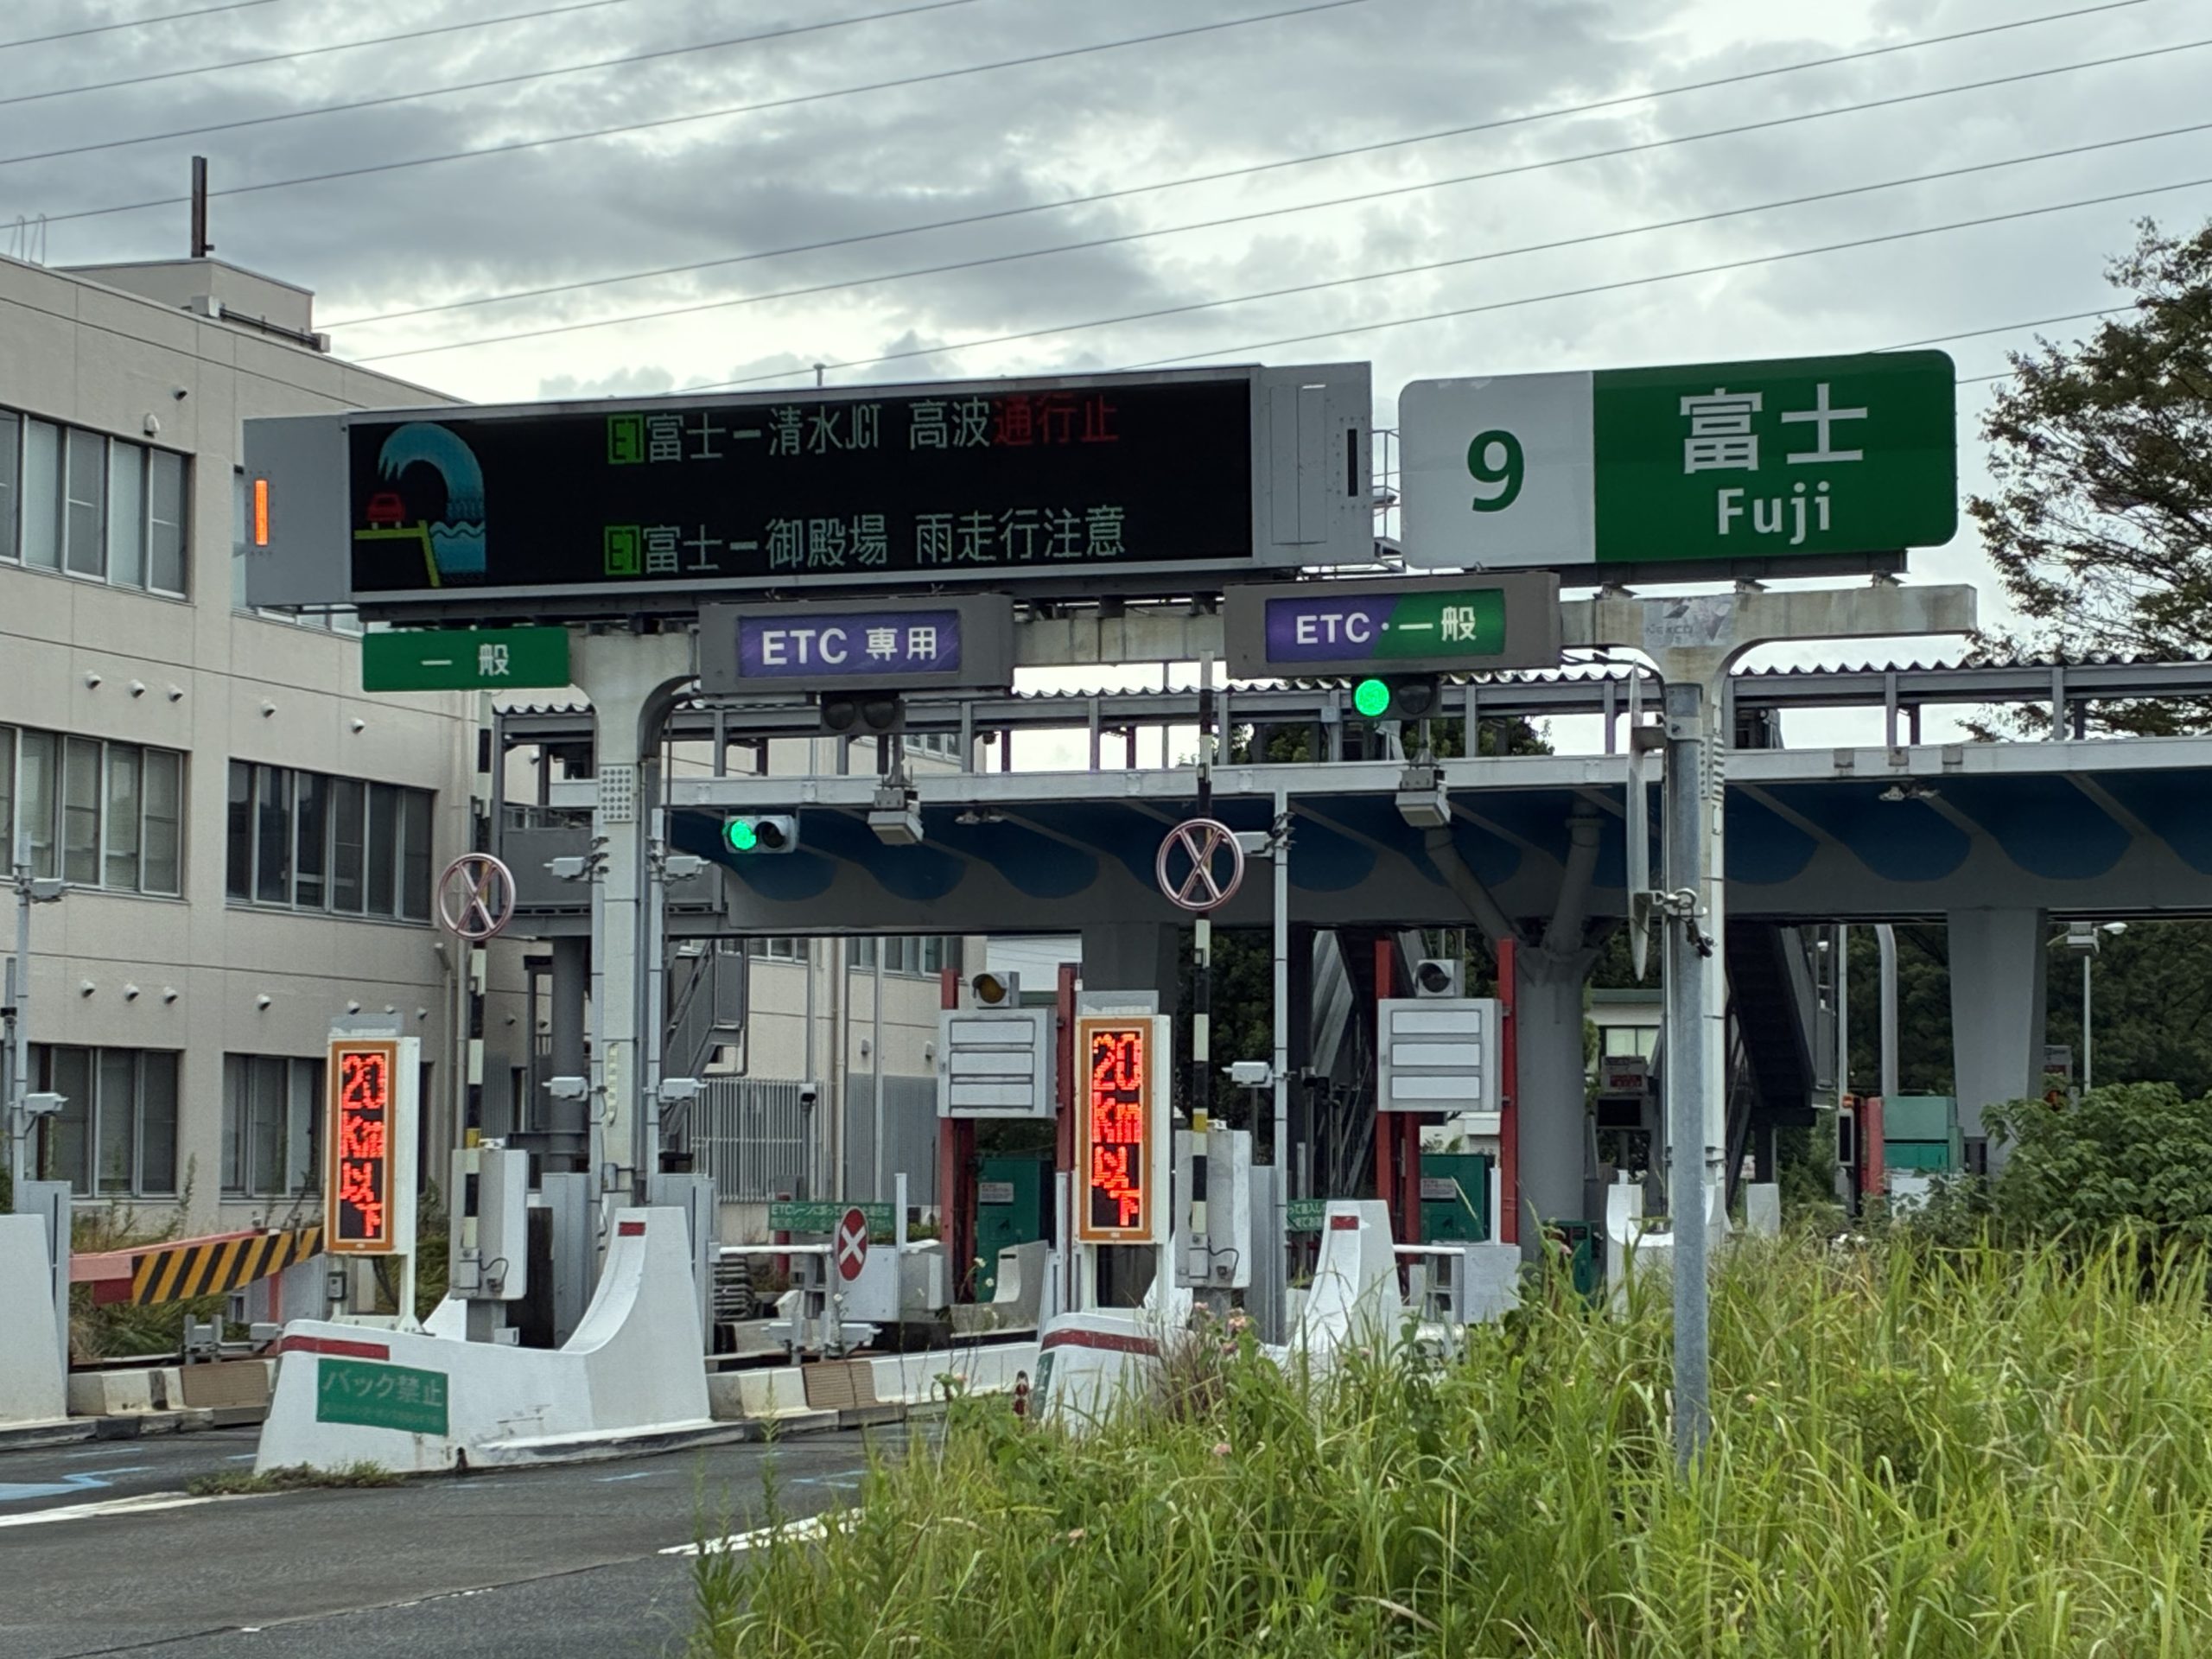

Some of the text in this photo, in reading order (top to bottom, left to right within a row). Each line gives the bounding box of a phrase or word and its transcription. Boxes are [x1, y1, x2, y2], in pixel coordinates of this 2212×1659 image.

[1680, 383, 1868, 474] 富士
[1466, 429, 1525, 513] 9
[915, 505, 1126, 564] 雨走行注意
[1717, 480, 1831, 545] Fuji
[421, 643, 511, 677] 一般
[322, 1369, 443, 1408] バック禁止
